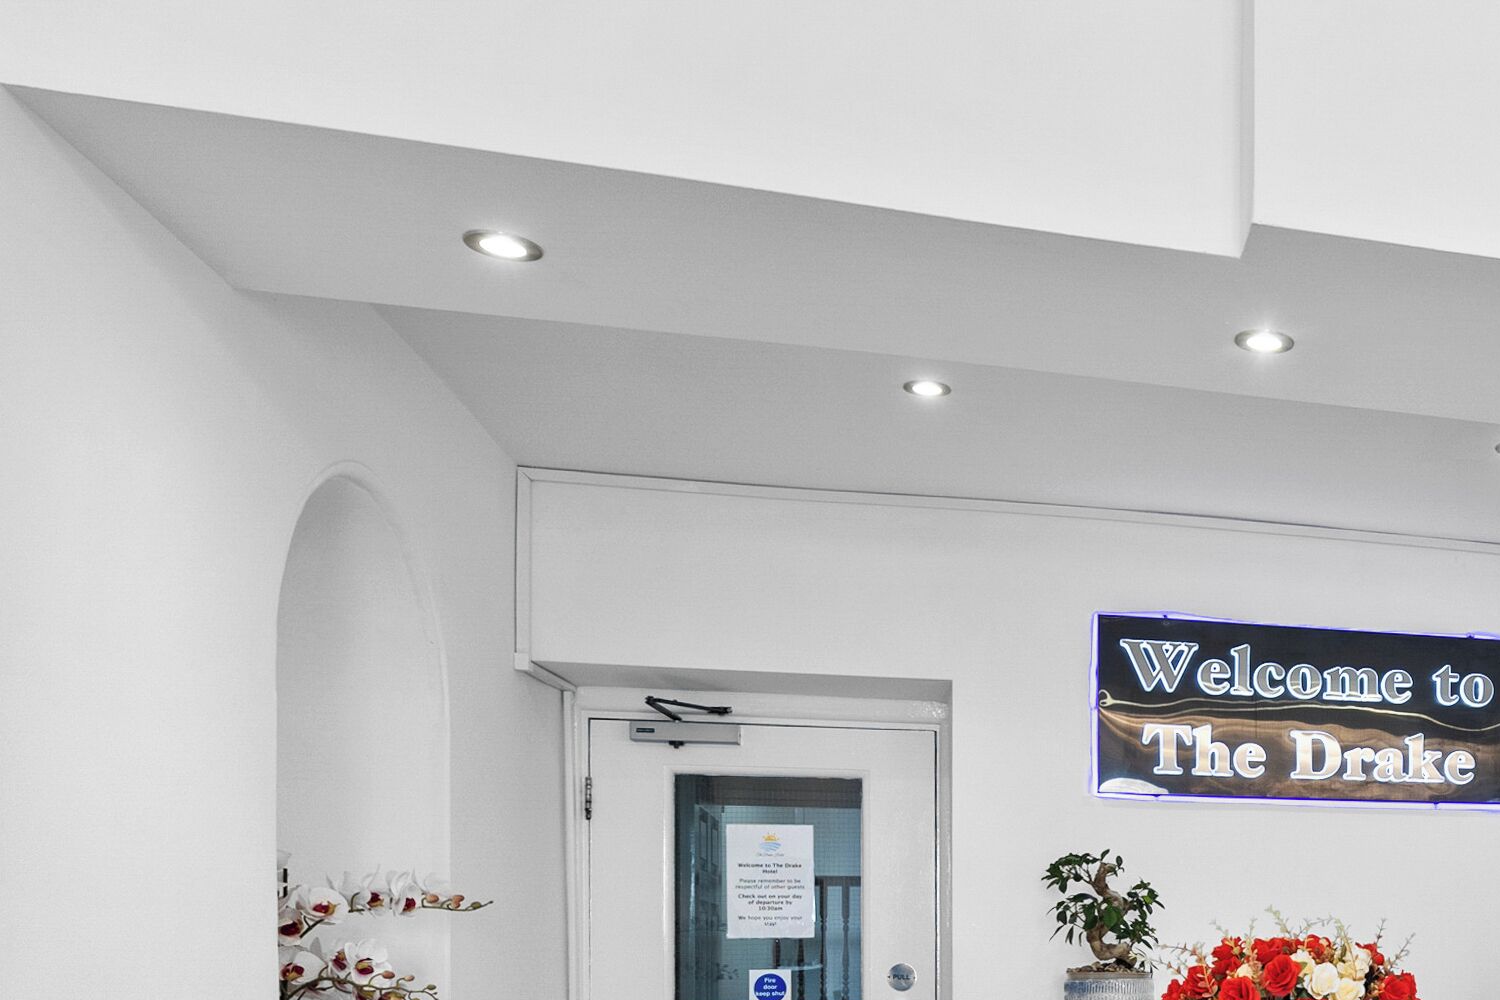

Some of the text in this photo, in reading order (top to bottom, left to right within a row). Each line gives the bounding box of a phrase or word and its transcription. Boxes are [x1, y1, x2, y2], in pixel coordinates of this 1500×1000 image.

[1119, 638, 1495, 708] Welcome to
[1141, 723, 1477, 786] The Drake
